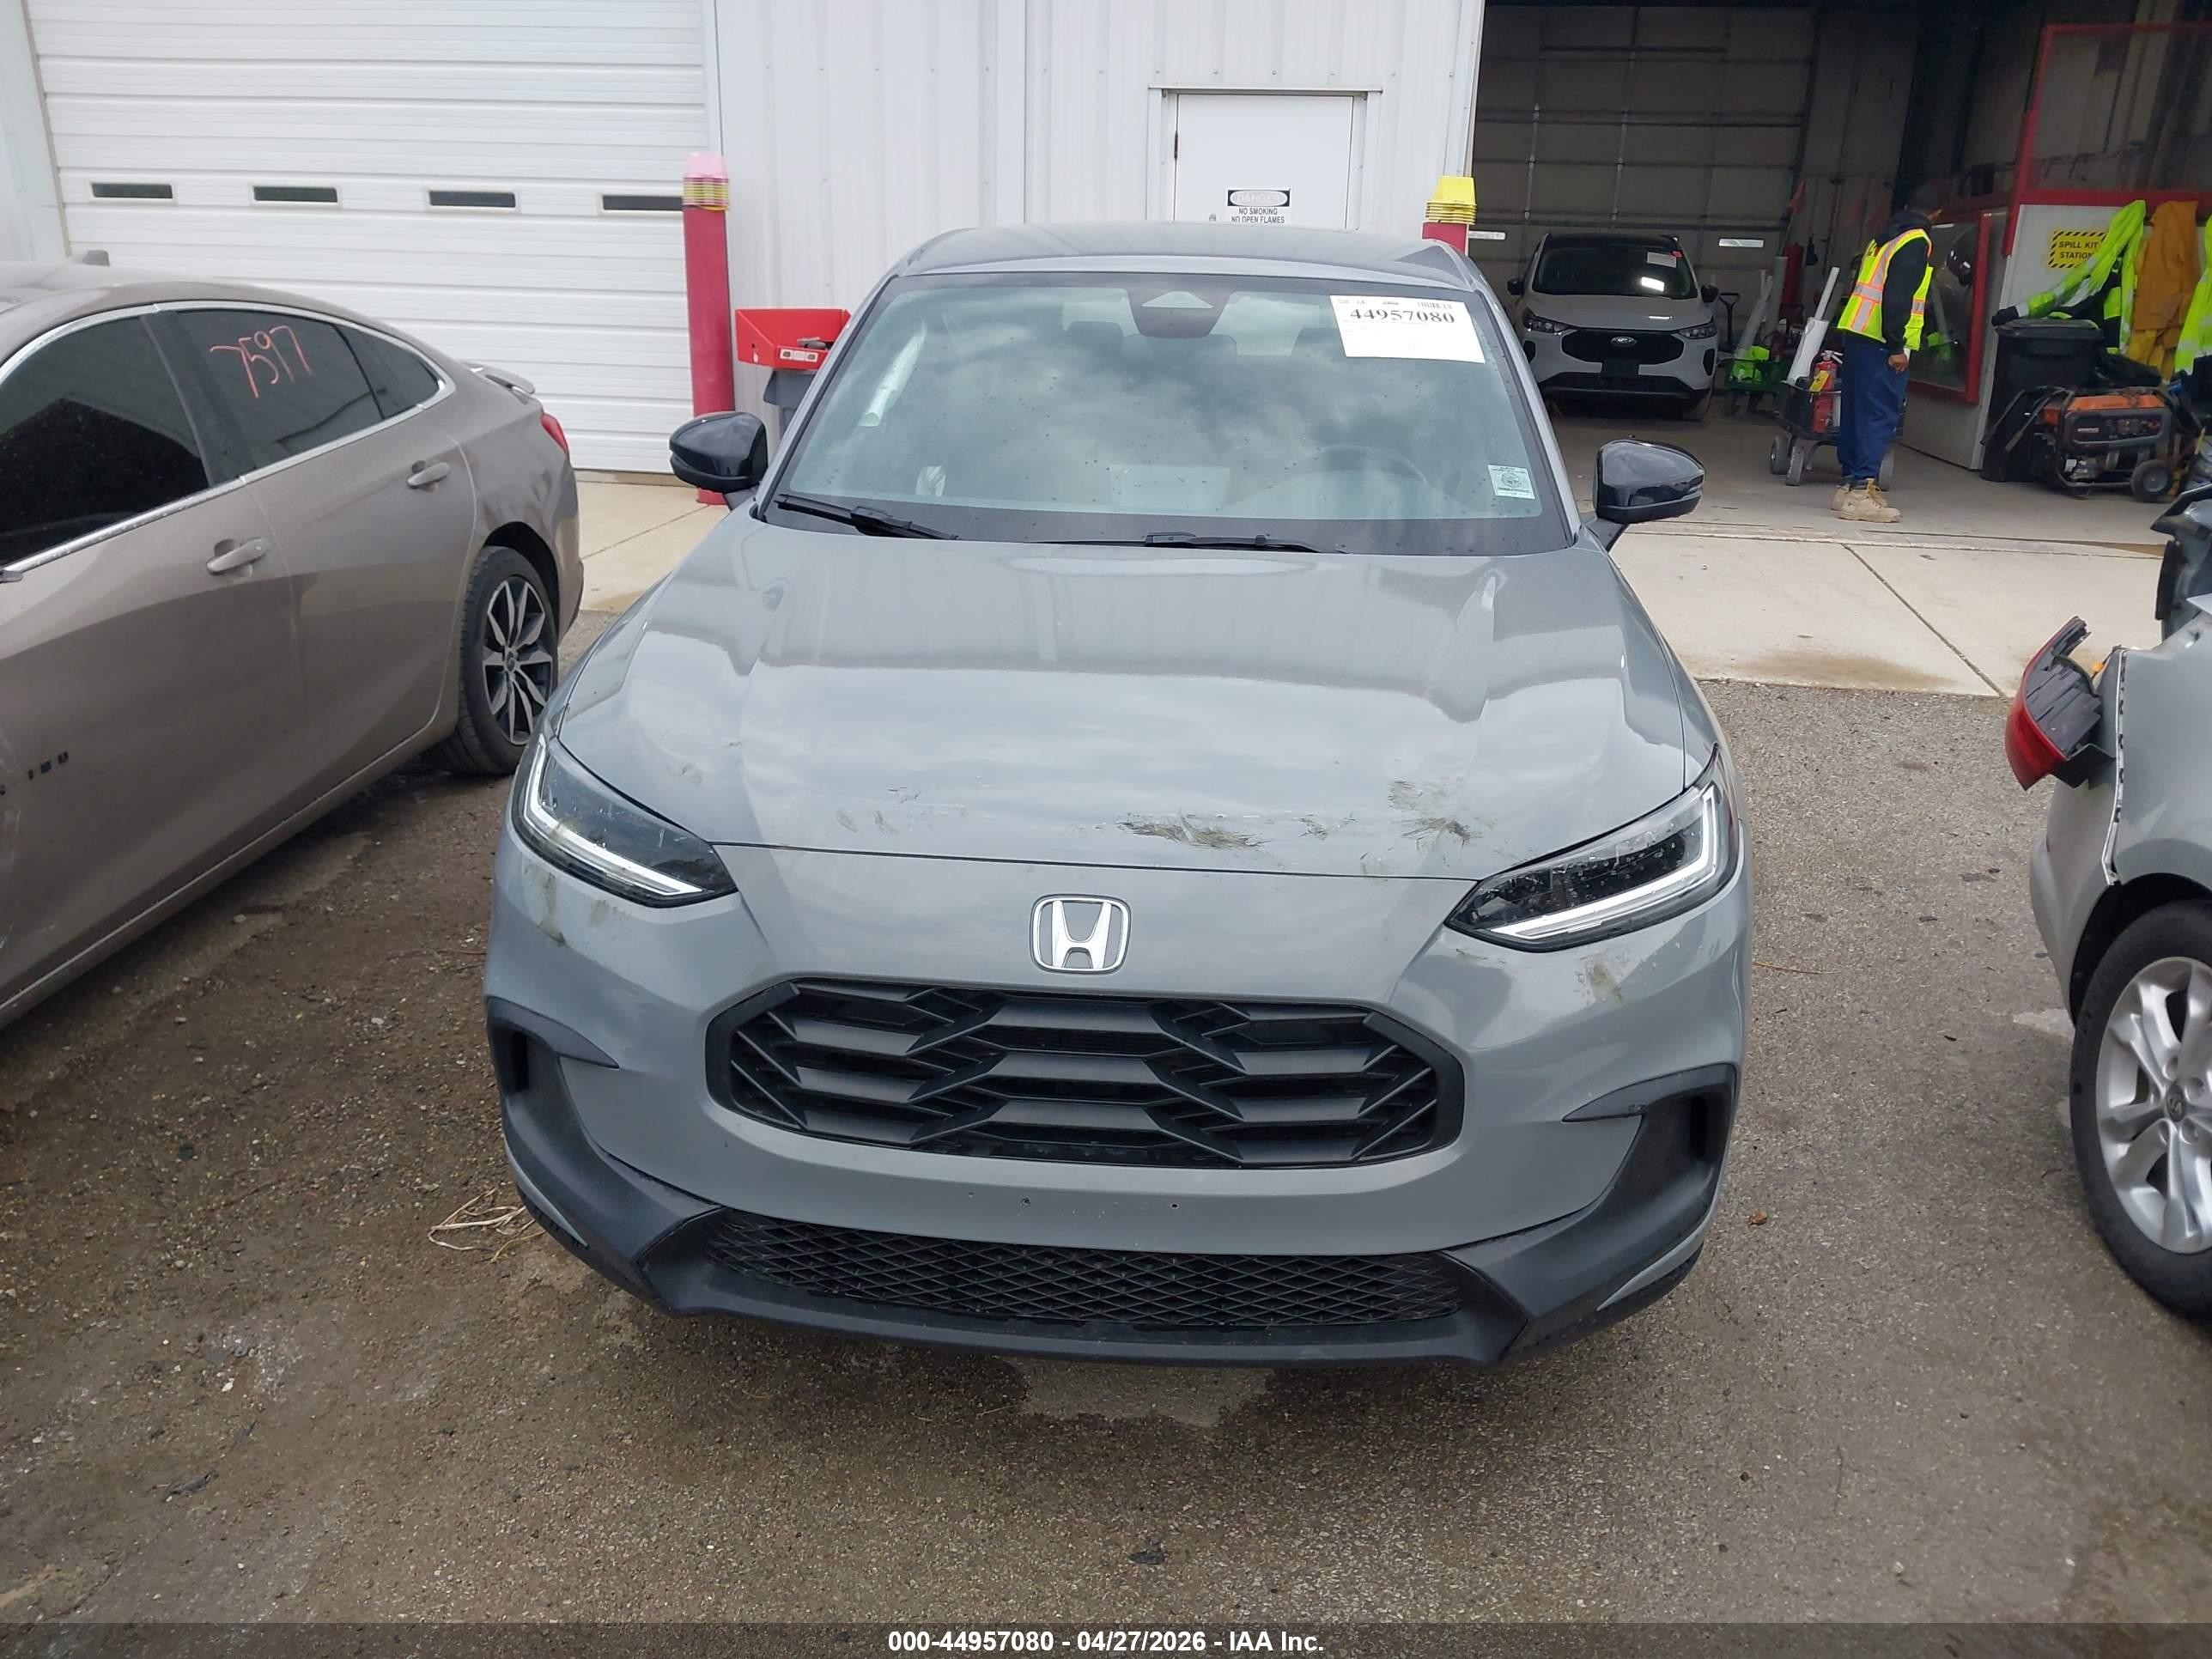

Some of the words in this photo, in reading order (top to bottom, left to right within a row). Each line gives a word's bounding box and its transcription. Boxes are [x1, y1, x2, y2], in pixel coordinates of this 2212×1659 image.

[1237, 194, 1279, 203] DANGER
[1350, 308, 1455, 324] 44957080
[210, 325, 312, 398] 7597
